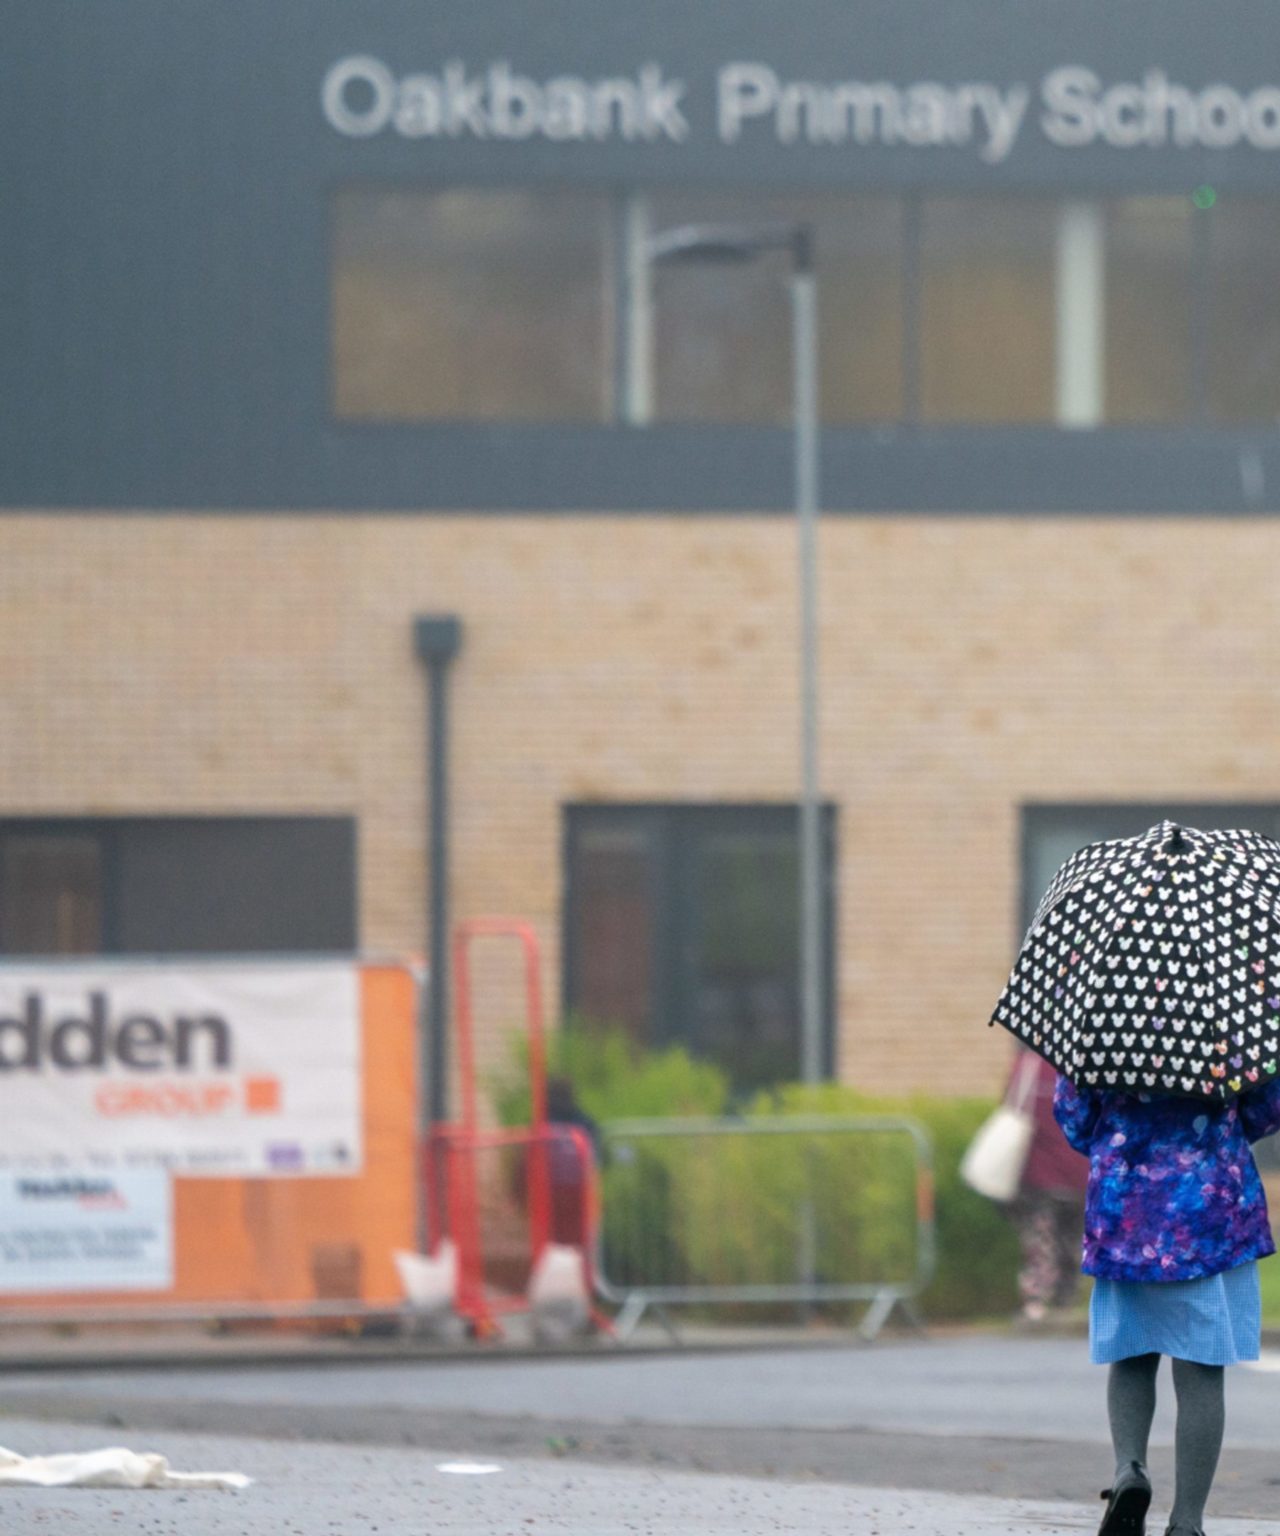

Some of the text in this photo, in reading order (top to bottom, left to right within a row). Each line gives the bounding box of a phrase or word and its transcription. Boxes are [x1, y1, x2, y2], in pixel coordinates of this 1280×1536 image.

[321, 54, 688, 143] Oakbank
[716, 62, 1028, 163] Primary
[0, 990, 232, 1071] dden
[95, 1078, 232, 1118] GROUP
